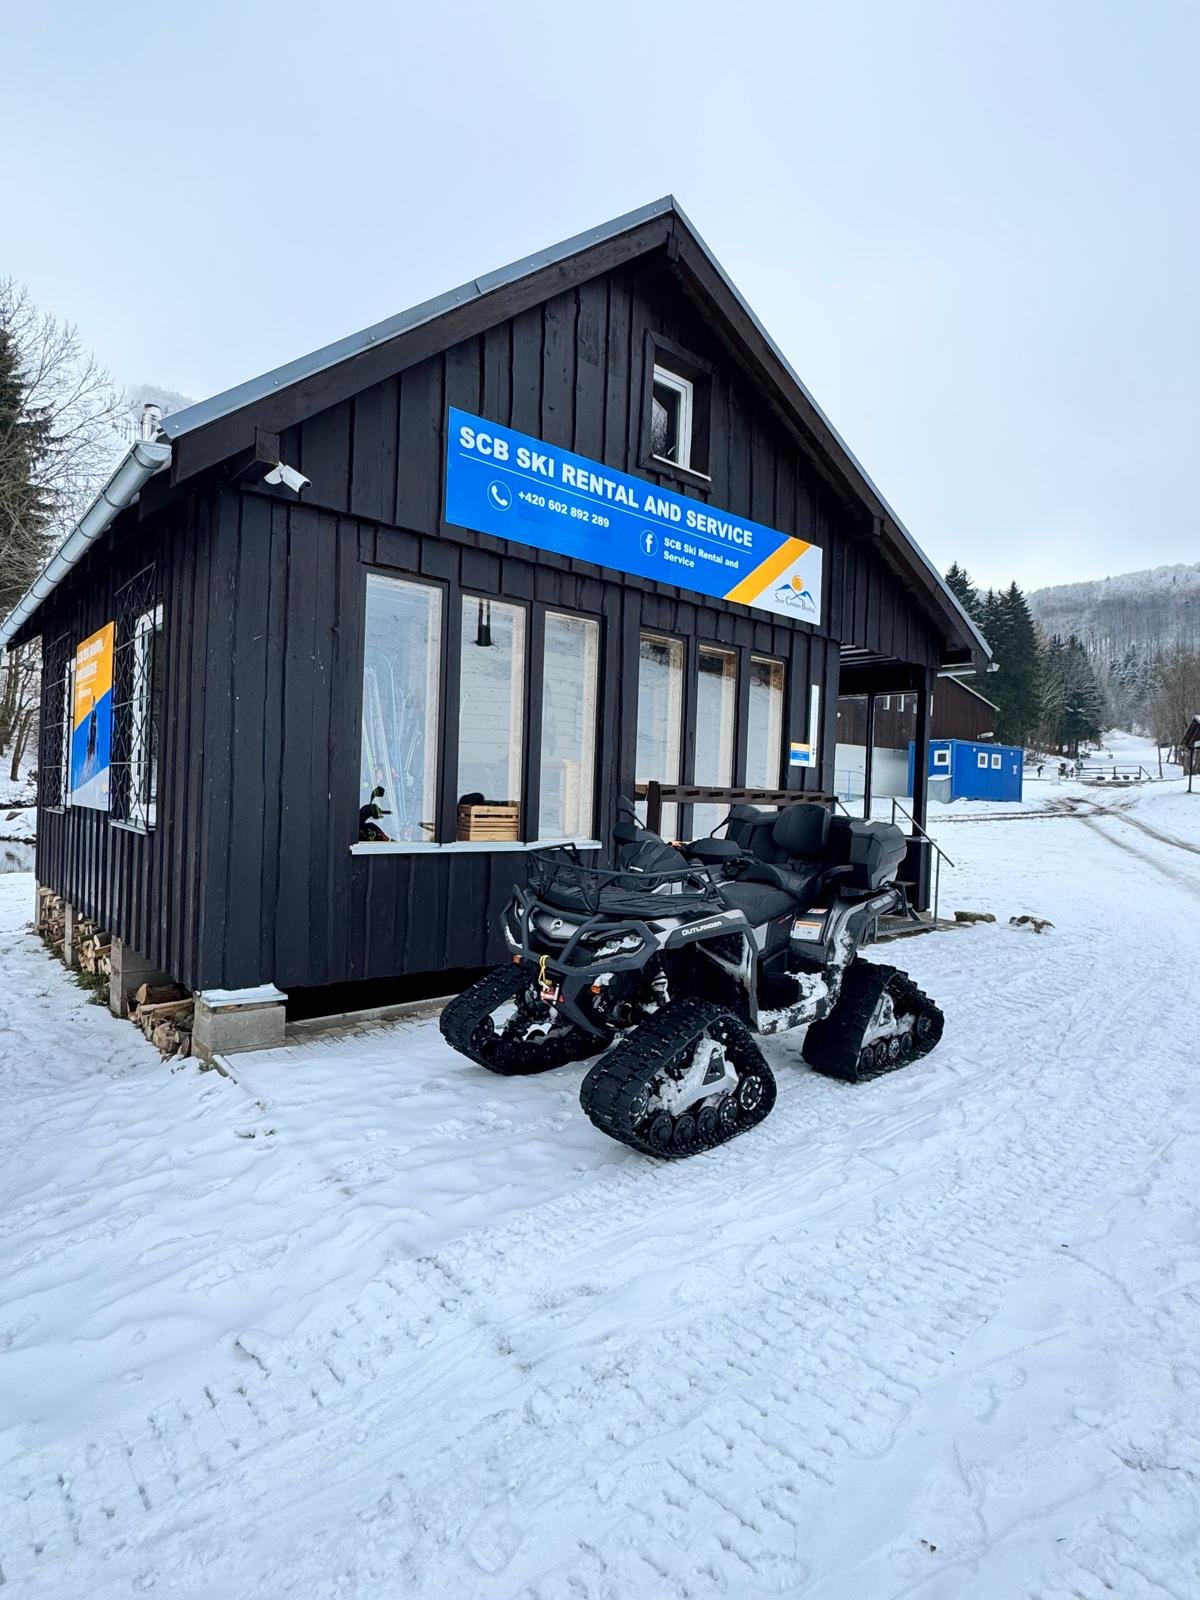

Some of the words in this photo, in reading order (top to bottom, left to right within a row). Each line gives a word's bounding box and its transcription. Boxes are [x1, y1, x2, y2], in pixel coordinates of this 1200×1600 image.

[459, 426, 509, 461] SCB
[516, 448, 555, 478] SKI
[562, 463, 639, 508] RENTAL
[644, 495, 681, 522] AND
[686, 511, 752, 547] SERVICE
[518, 491, 545, 507] +420
[548, 501, 568, 515] 602
[571, 508, 589, 522] 892
[592, 514, 609, 528] 289
[663, 551, 695, 568] Service
[664, 537, 681, 551] SCB
[684, 544, 696, 556] Ski
[698, 549, 723, 565] Rental
[725, 557, 739, 569] and
